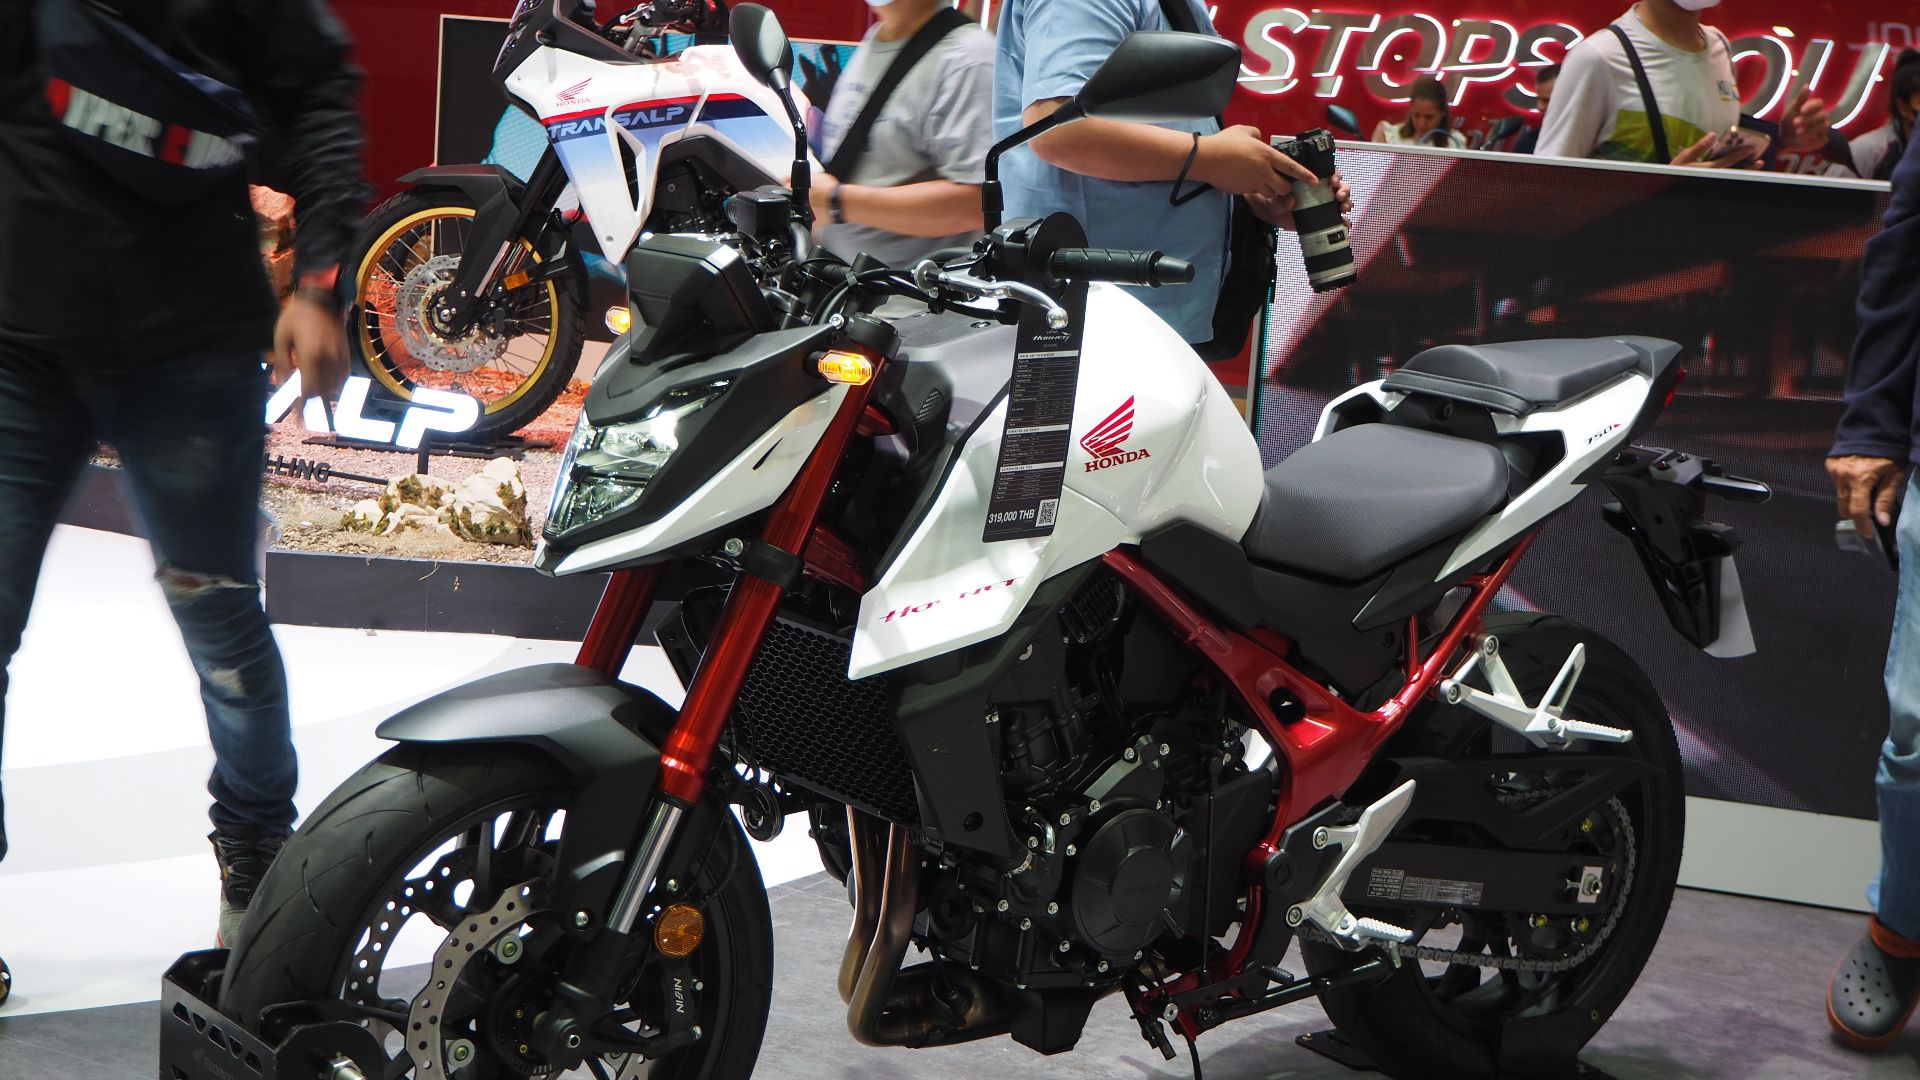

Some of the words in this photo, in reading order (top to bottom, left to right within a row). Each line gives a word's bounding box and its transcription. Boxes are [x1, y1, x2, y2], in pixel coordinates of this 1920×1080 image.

[1237, 8, 1584, 113] STOPS
[1731, 35, 1890, 130] OU
[556, 98, 591, 107] HONDA
[548, 106, 684, 139] TRANSALP
[262, 364, 479, 449] ALP
[264, 452, 331, 483] LLING
[1084, 448, 1151, 473] HONDA
[988, 510, 1018, 525] 319,000
[1019, 508, 1035, 520] THB
